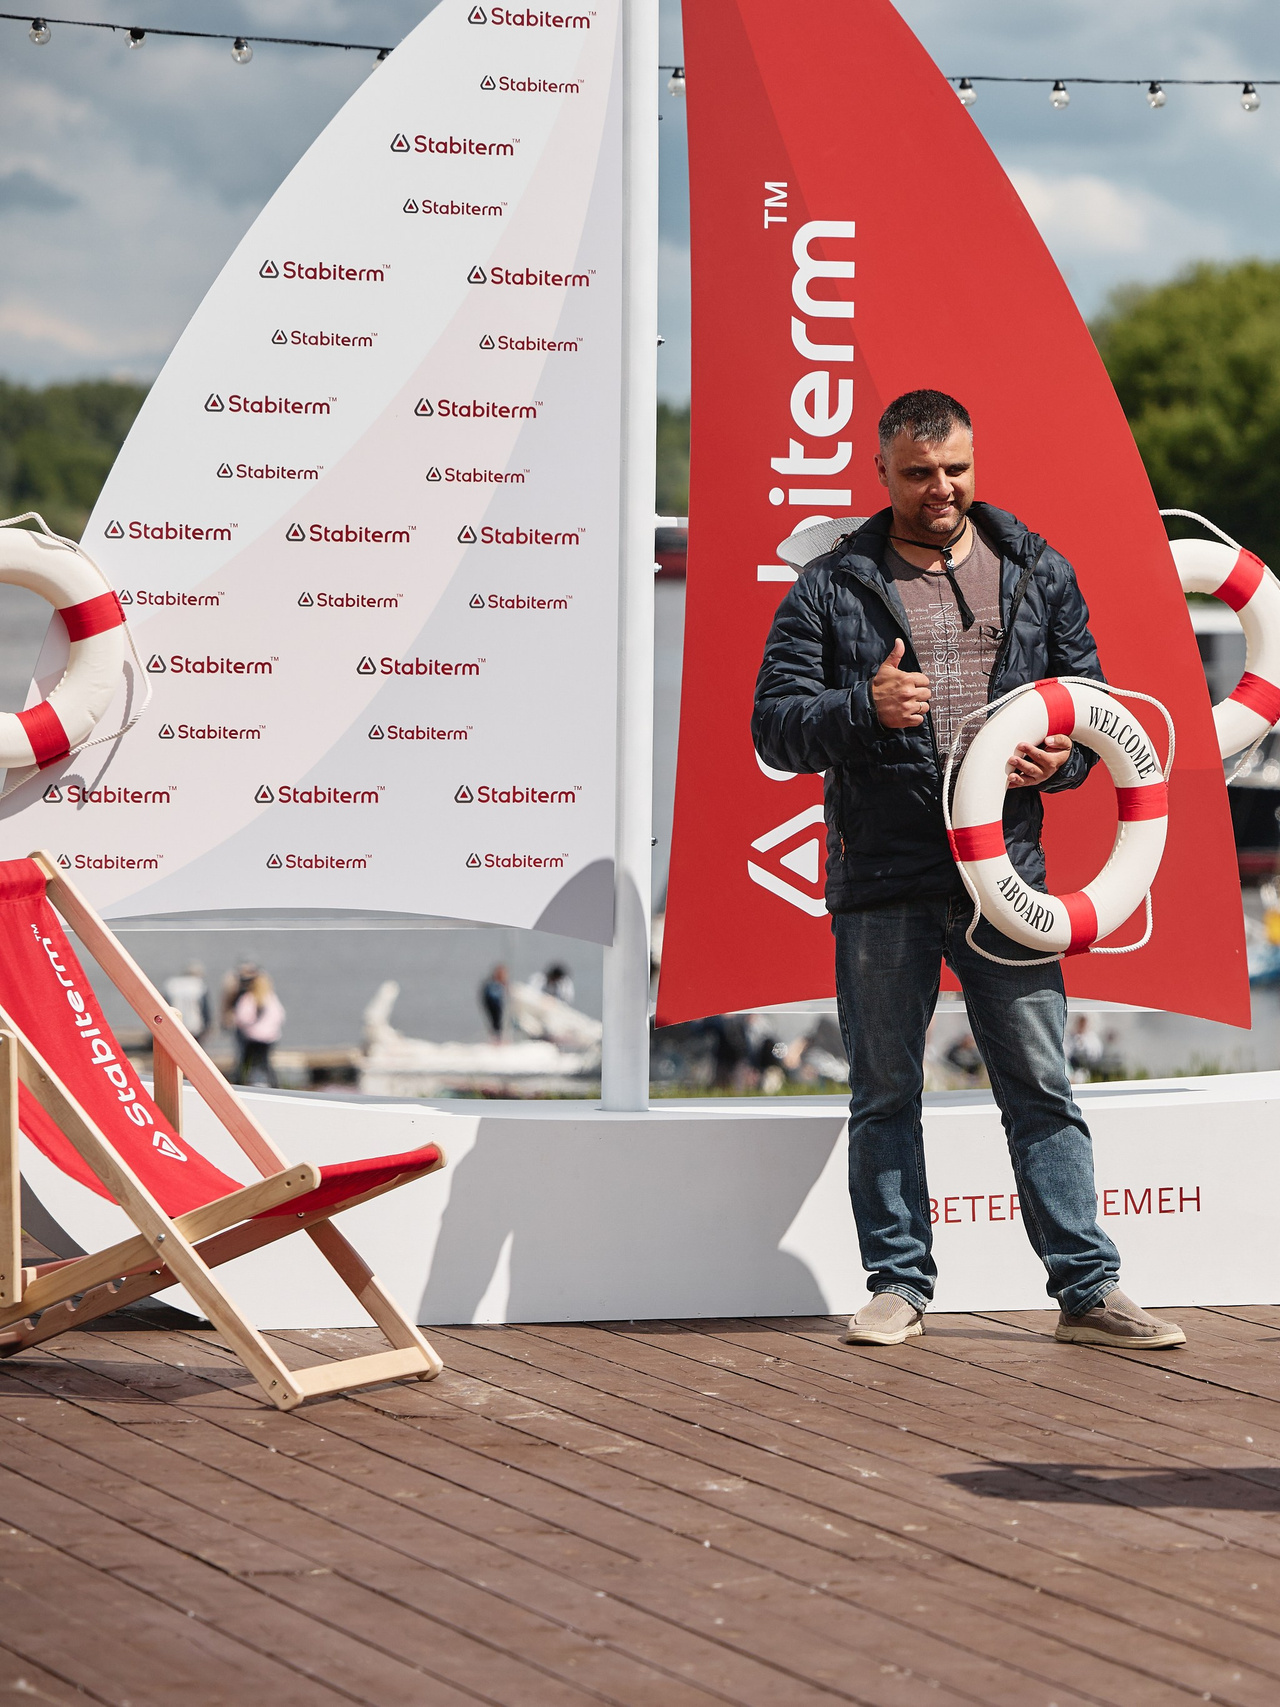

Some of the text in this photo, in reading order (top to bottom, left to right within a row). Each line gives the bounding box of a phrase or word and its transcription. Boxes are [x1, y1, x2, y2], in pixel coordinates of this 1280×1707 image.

[929, 602, 962, 697] DESIGN
[1088, 706, 1157, 780] WELCOME
[996, 874, 1055, 934] ABOARD
